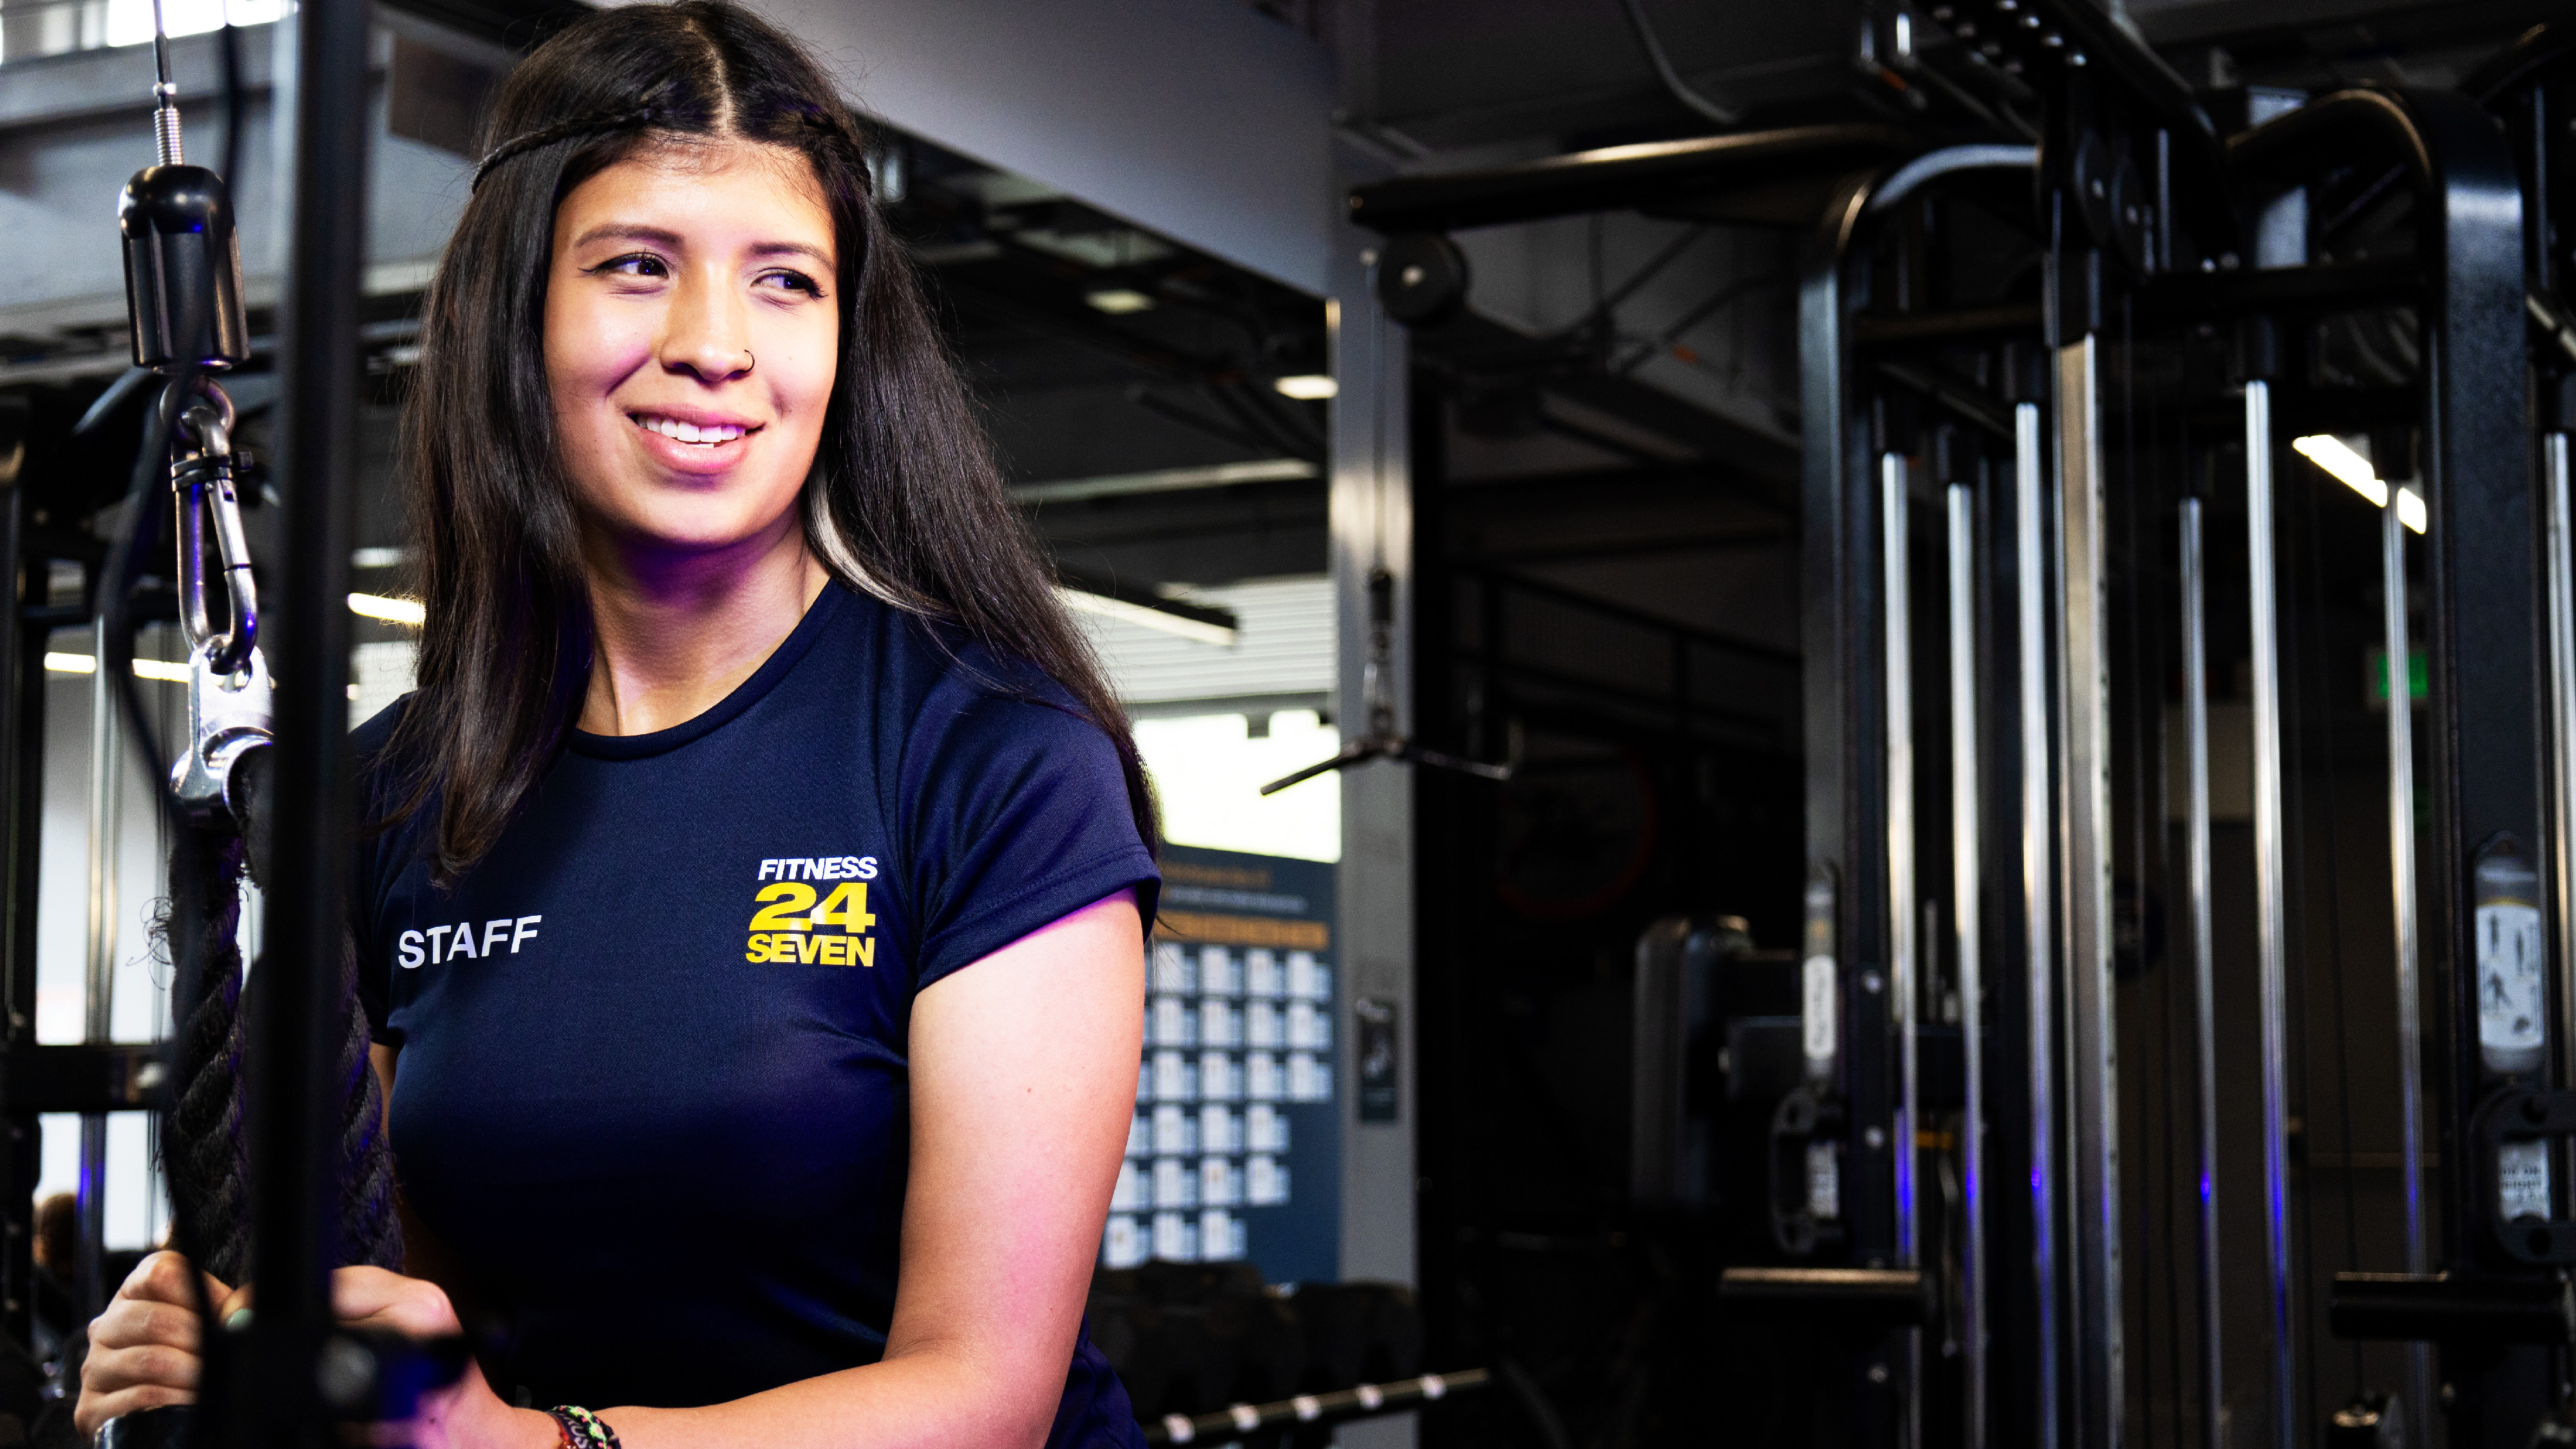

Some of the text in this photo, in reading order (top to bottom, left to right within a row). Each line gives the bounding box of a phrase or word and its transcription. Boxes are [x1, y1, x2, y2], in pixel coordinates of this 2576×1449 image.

[757, 856, 878, 880] FITNESS
[749, 882, 876, 933] 24
[398, 914, 542, 969] STAFF
[745, 933, 875, 967] SEVEN
